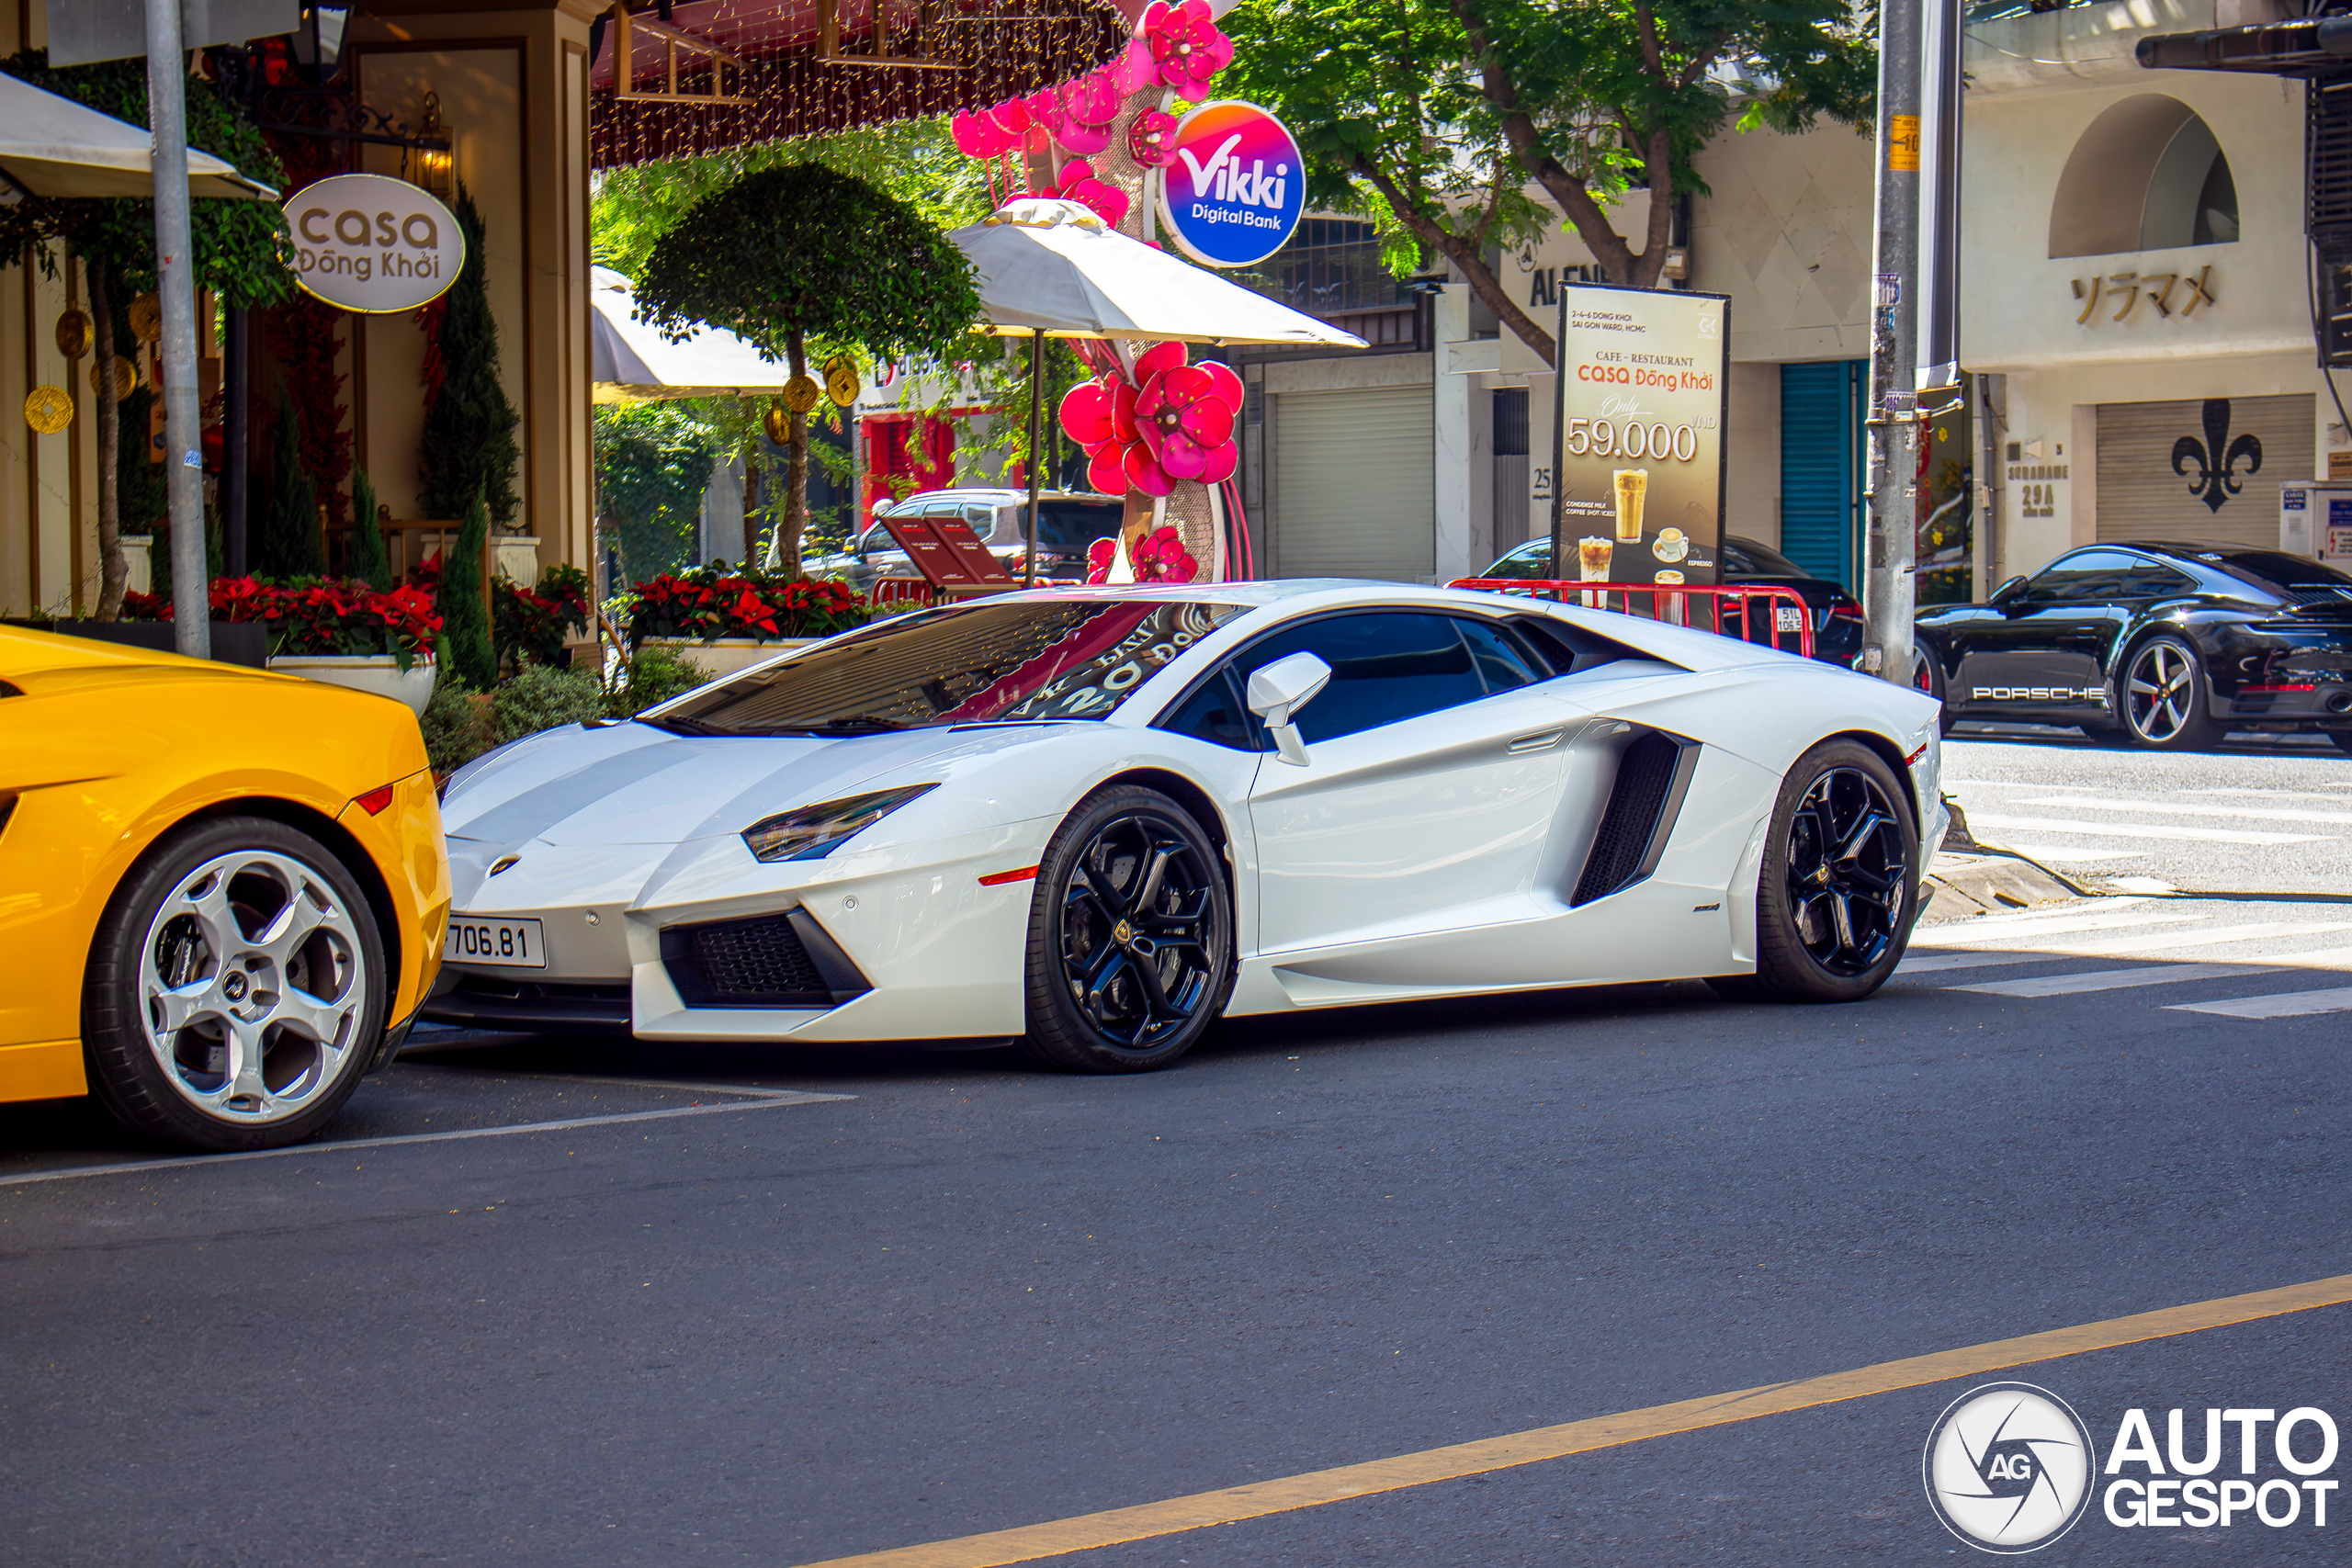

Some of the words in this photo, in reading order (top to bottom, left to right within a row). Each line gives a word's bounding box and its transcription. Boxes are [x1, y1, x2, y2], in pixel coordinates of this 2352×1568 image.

[1178, 133, 1288, 209] Vikki
[299, 208, 439, 250] casa
[1192, 203, 1243, 224] Digital
[1243, 211, 1283, 231] Bank
[381, 250, 440, 278] Khởi
[2071, 265, 2216, 323] ソラマメ
[1572, 320, 1583, 328] SAI
[1584, 321, 1600, 329] GON
[1592, 311, 1614, 321] DONG
[1596, 351, 1623, 363] CAFE
[1631, 354, 1695, 367] RESTAURANT
[1578, 364, 1630, 384] casa
[1600, 394, 1654, 421] Only
[1567, 417, 1698, 462] 59.000
[1534, 468, 1551, 489] 25
[1973, 686, 2106, 700] PORSCHE
[446, 924, 527, 958] 706.81
